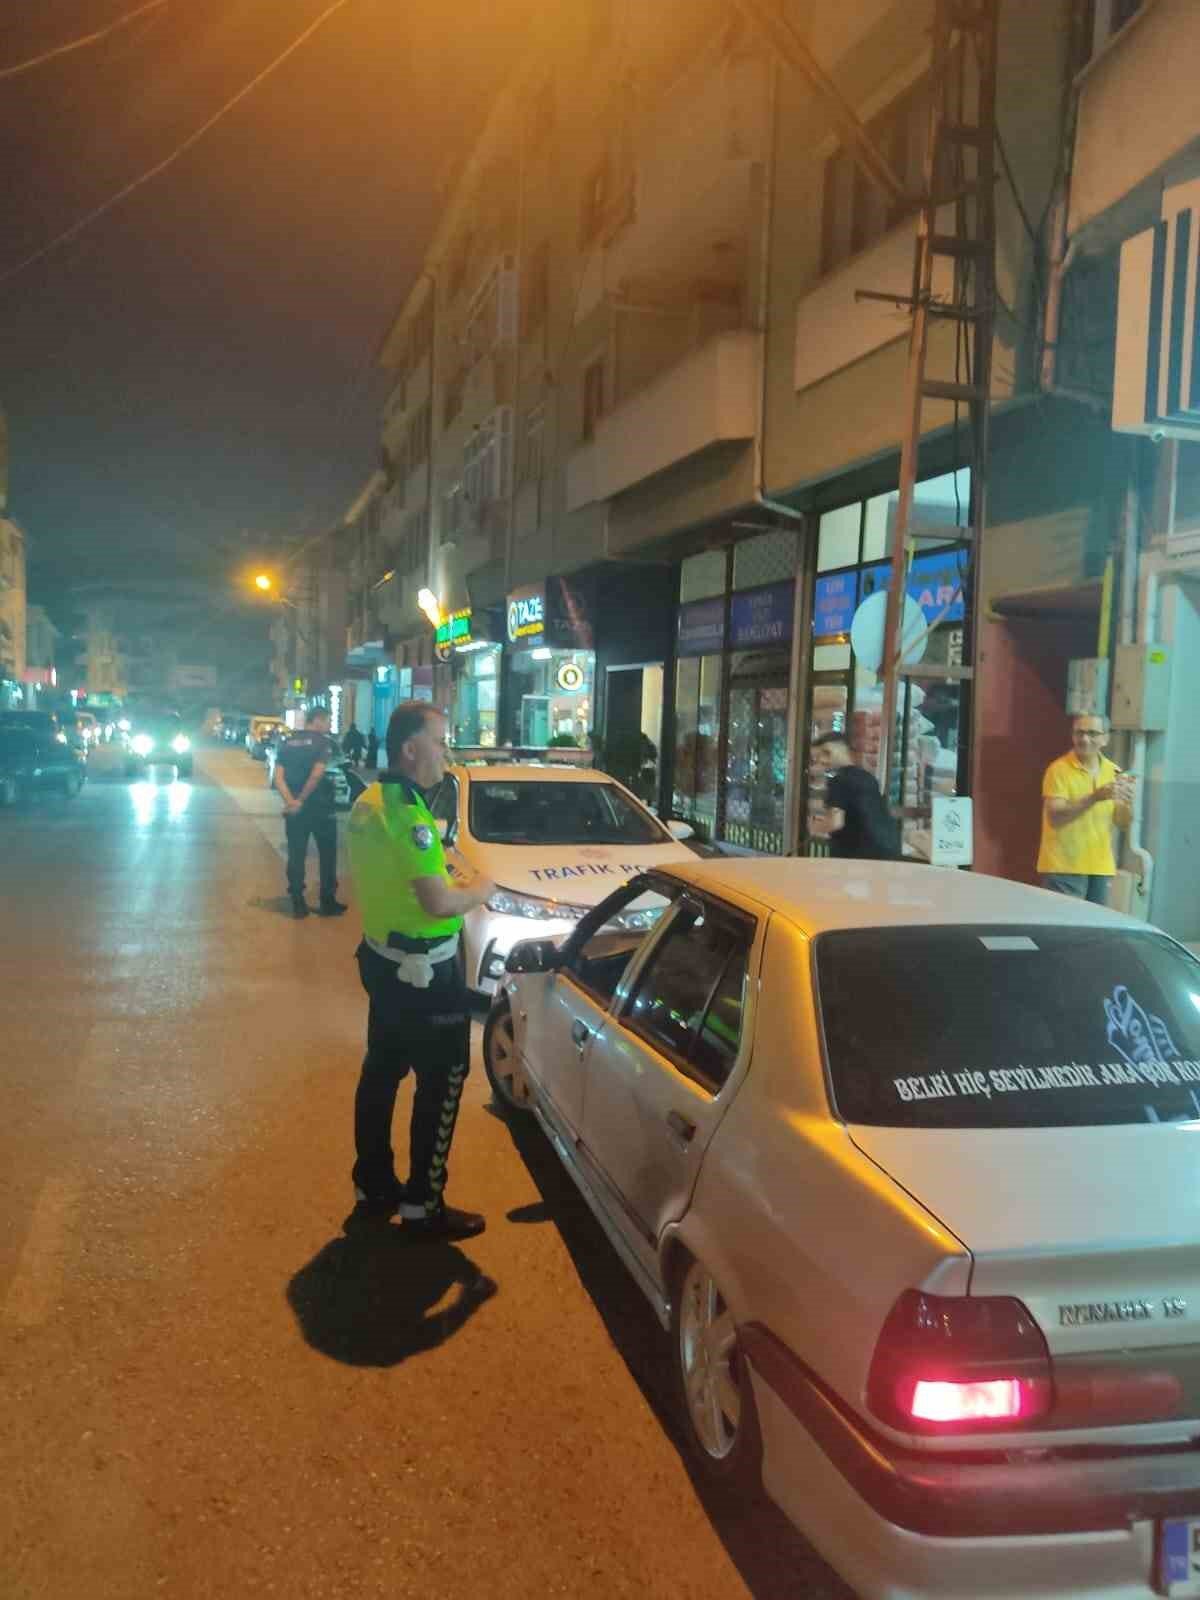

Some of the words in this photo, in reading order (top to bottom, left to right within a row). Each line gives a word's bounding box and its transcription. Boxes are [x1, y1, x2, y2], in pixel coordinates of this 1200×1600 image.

[517, 597, 543, 625] TAZE
[893, 1071, 956, 1102] BELKİ
[954, 1067, 992, 1100] HİÇ
[989, 1061, 1102, 1094] SEVİLMEDİK
